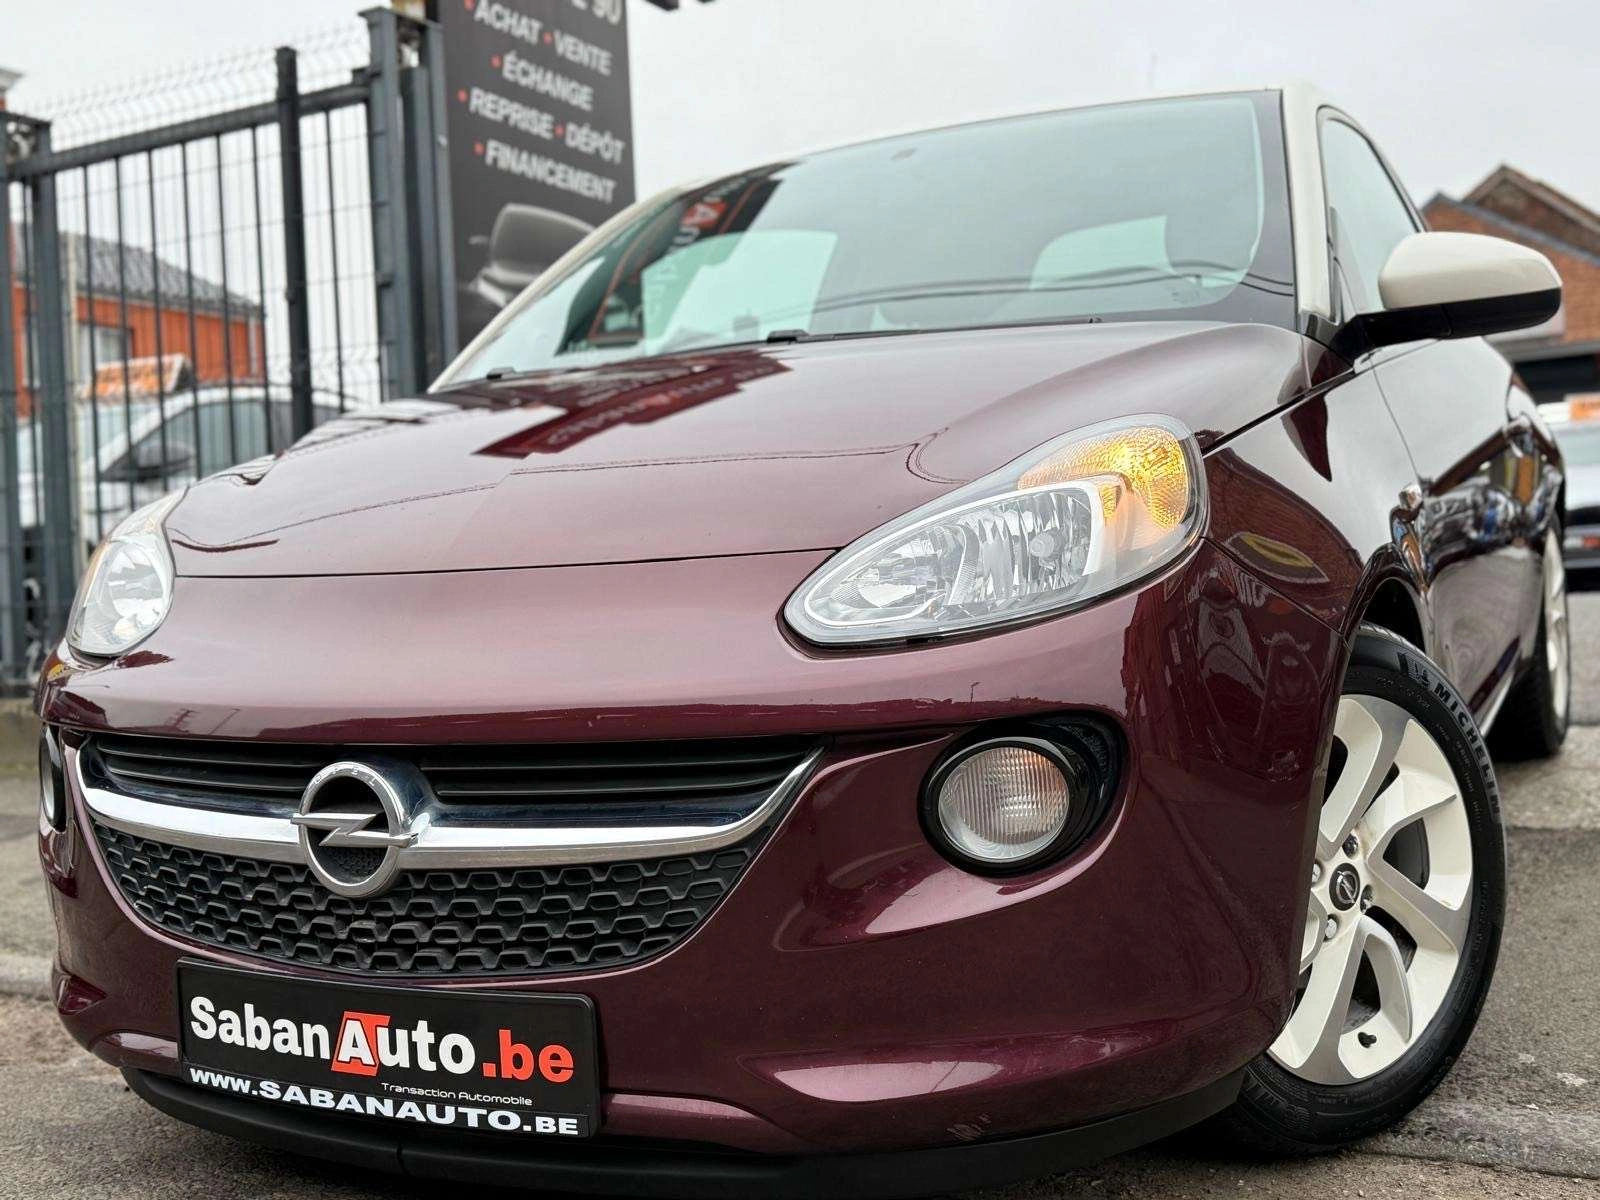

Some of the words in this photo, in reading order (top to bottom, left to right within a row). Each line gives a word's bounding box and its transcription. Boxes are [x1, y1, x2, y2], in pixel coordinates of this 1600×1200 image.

[474, 0, 543, 45] ACHAT
[553, 29, 612, 76] VENTE
[502, 50, 593, 112] ÉCHANGE
[469, 86, 554, 140] REPRISE
[565, 122, 625, 164] DÉPÔT
[485, 139, 617, 204] FINANCEMENT
[1434, 682, 1501, 816] MICHELIN
[381, 1082, 456, 1099] Transaction
[458, 1091, 533, 1106] Automobile
